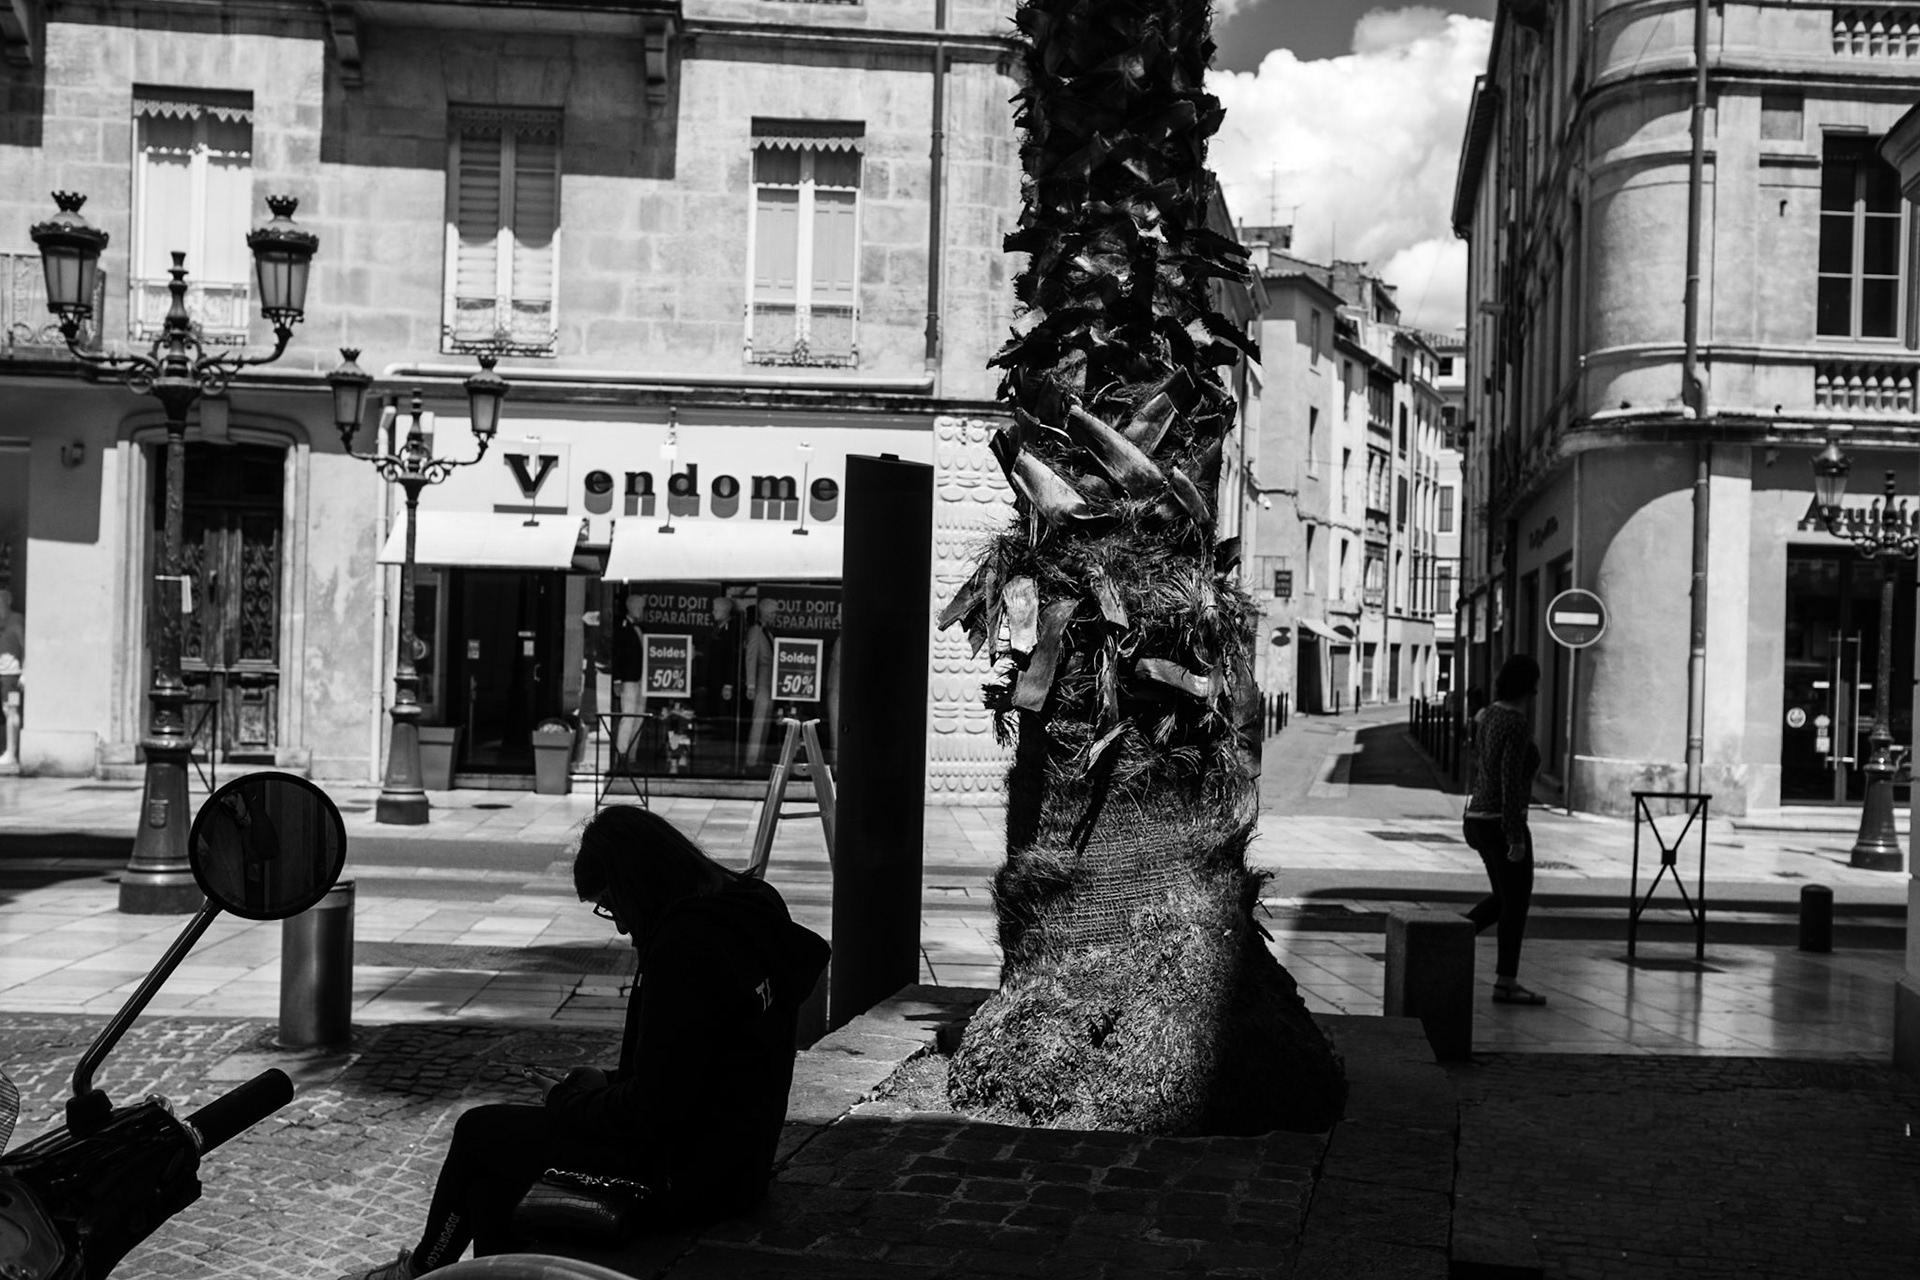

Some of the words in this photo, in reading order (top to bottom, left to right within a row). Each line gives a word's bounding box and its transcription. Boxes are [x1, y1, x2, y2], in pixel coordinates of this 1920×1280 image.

[504, 453, 839, 517] Vendome
[678, 595, 708, 610] DOIT
[777, 599, 803, 612] OUT
[806, 600, 836, 613] DOIT
[649, 646, 686, 659] Soldes
[779, 651, 816, 664] Soldes
